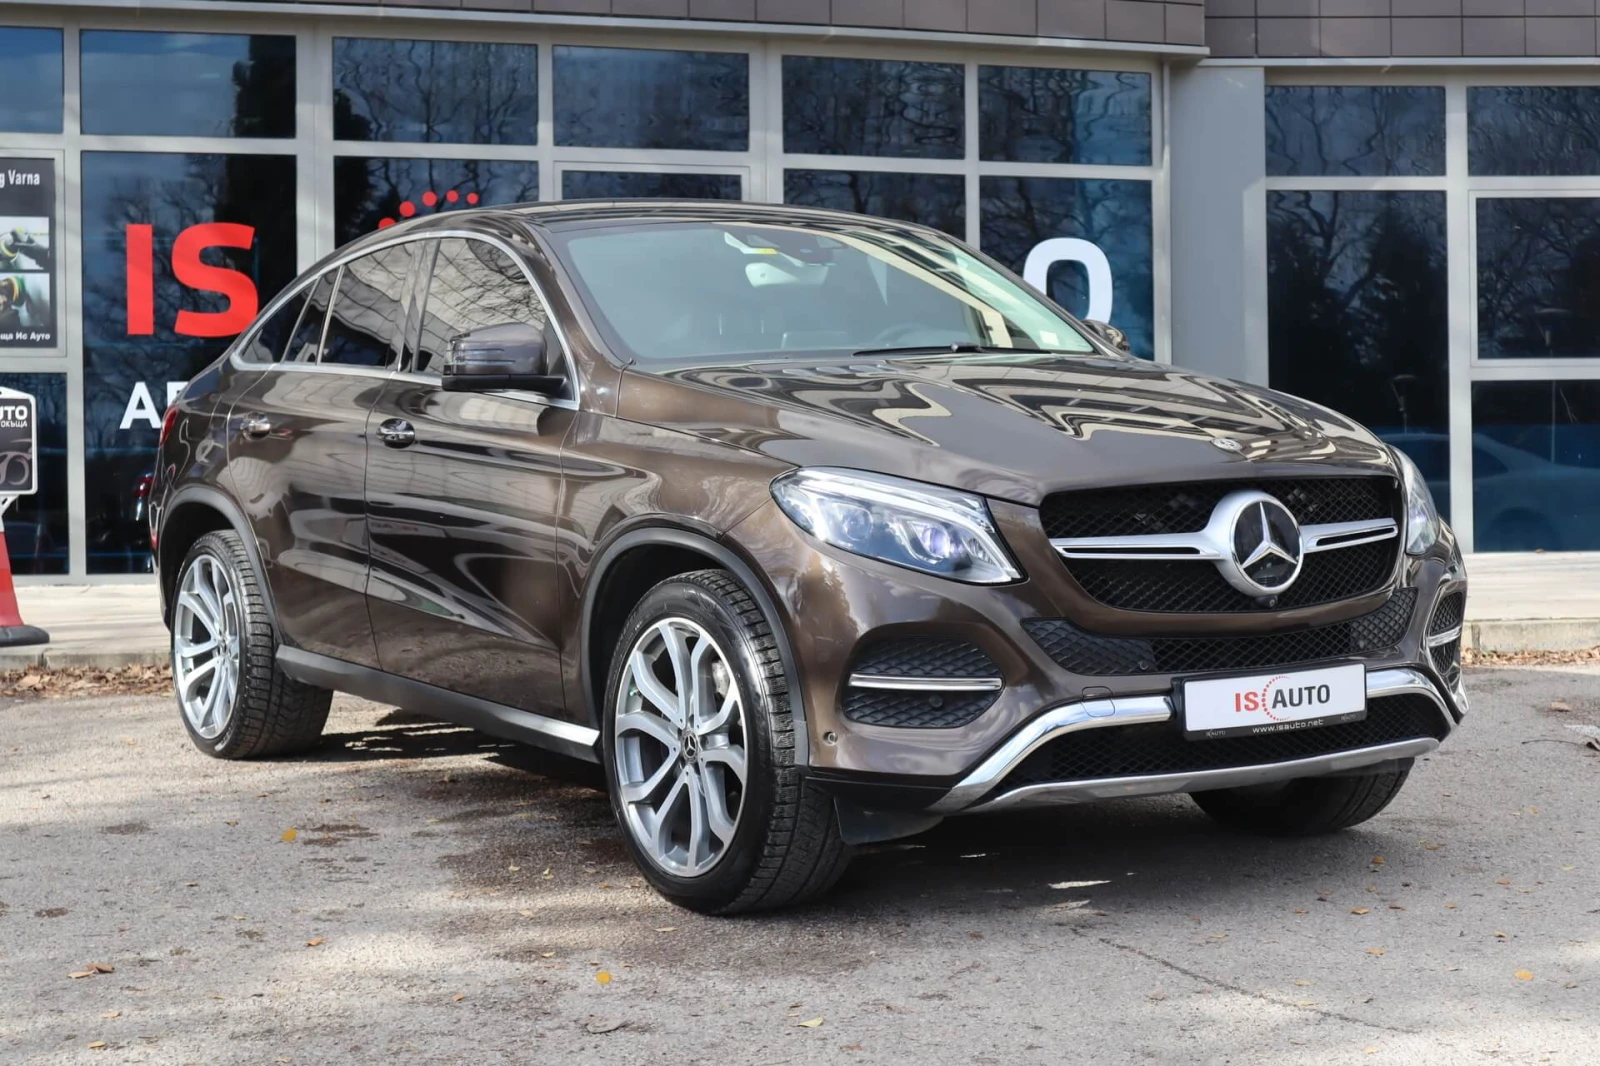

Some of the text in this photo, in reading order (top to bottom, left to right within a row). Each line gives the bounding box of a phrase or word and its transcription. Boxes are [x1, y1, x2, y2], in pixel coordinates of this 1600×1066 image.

[8, 169, 40, 186] Varna
[126, 222, 259, 338] IS
[30, 331, 51, 342] Ауто
[1235, 684, 1330, 712] IS AUTO
[1252, 719, 1324, 734] www.isauto.net
